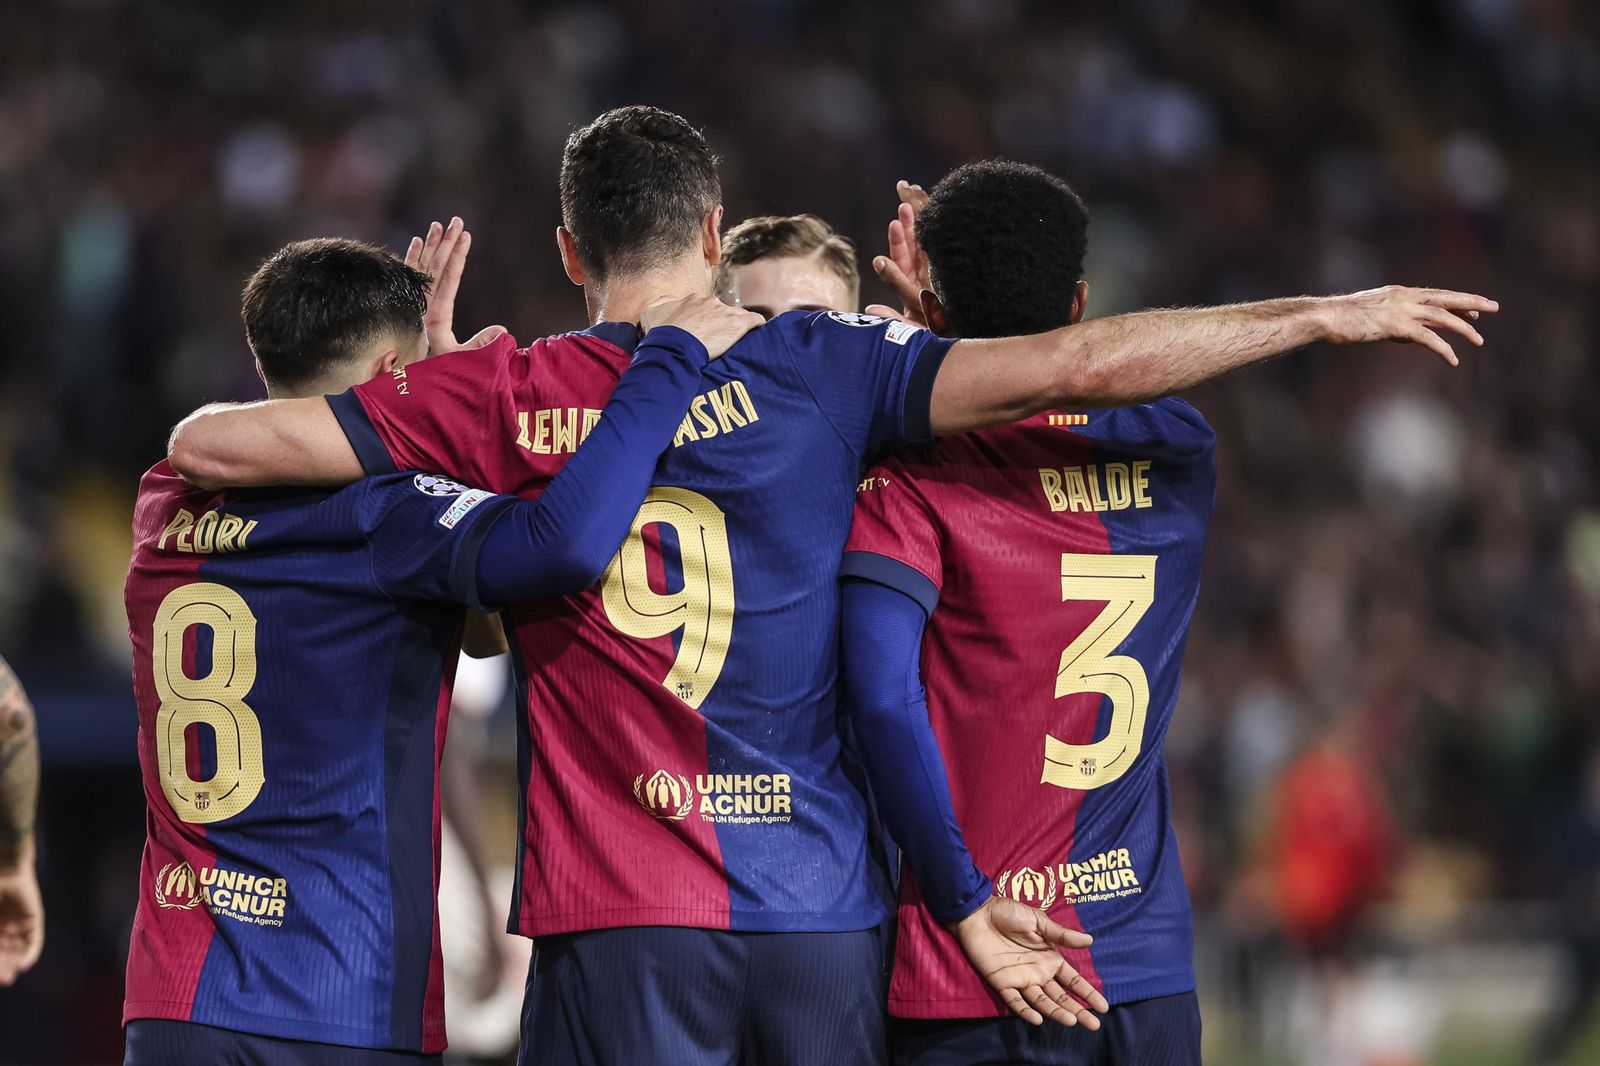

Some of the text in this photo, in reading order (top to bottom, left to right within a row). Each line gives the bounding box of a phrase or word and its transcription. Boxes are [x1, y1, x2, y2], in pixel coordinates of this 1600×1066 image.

[515, 380, 760, 455] LEWAWSKI
[1038, 460, 1153, 513] BALDE
[441, 506, 457, 523] UEFA
[157, 507, 259, 554] PEDRI
[601, 486, 736, 711] 9
[1040, 552, 1159, 791] 3
[152, 582, 266, 824] 8
[696, 773, 791, 794] UNHCR
[699, 794, 791, 815] ACNUR
[701, 814, 791, 824] The UN Refugee Agency
[1058, 847, 1132, 883] UNHCR
[200, 866, 287, 898] UNHCR
[1063, 868, 1140, 897] ACNUR
[1065, 886, 1142, 905] The UN Refugee Agency
[202, 886, 286, 917] ACNUR
[221, 908, 254, 922] Refugee
[254, 916, 282, 927] Agency
